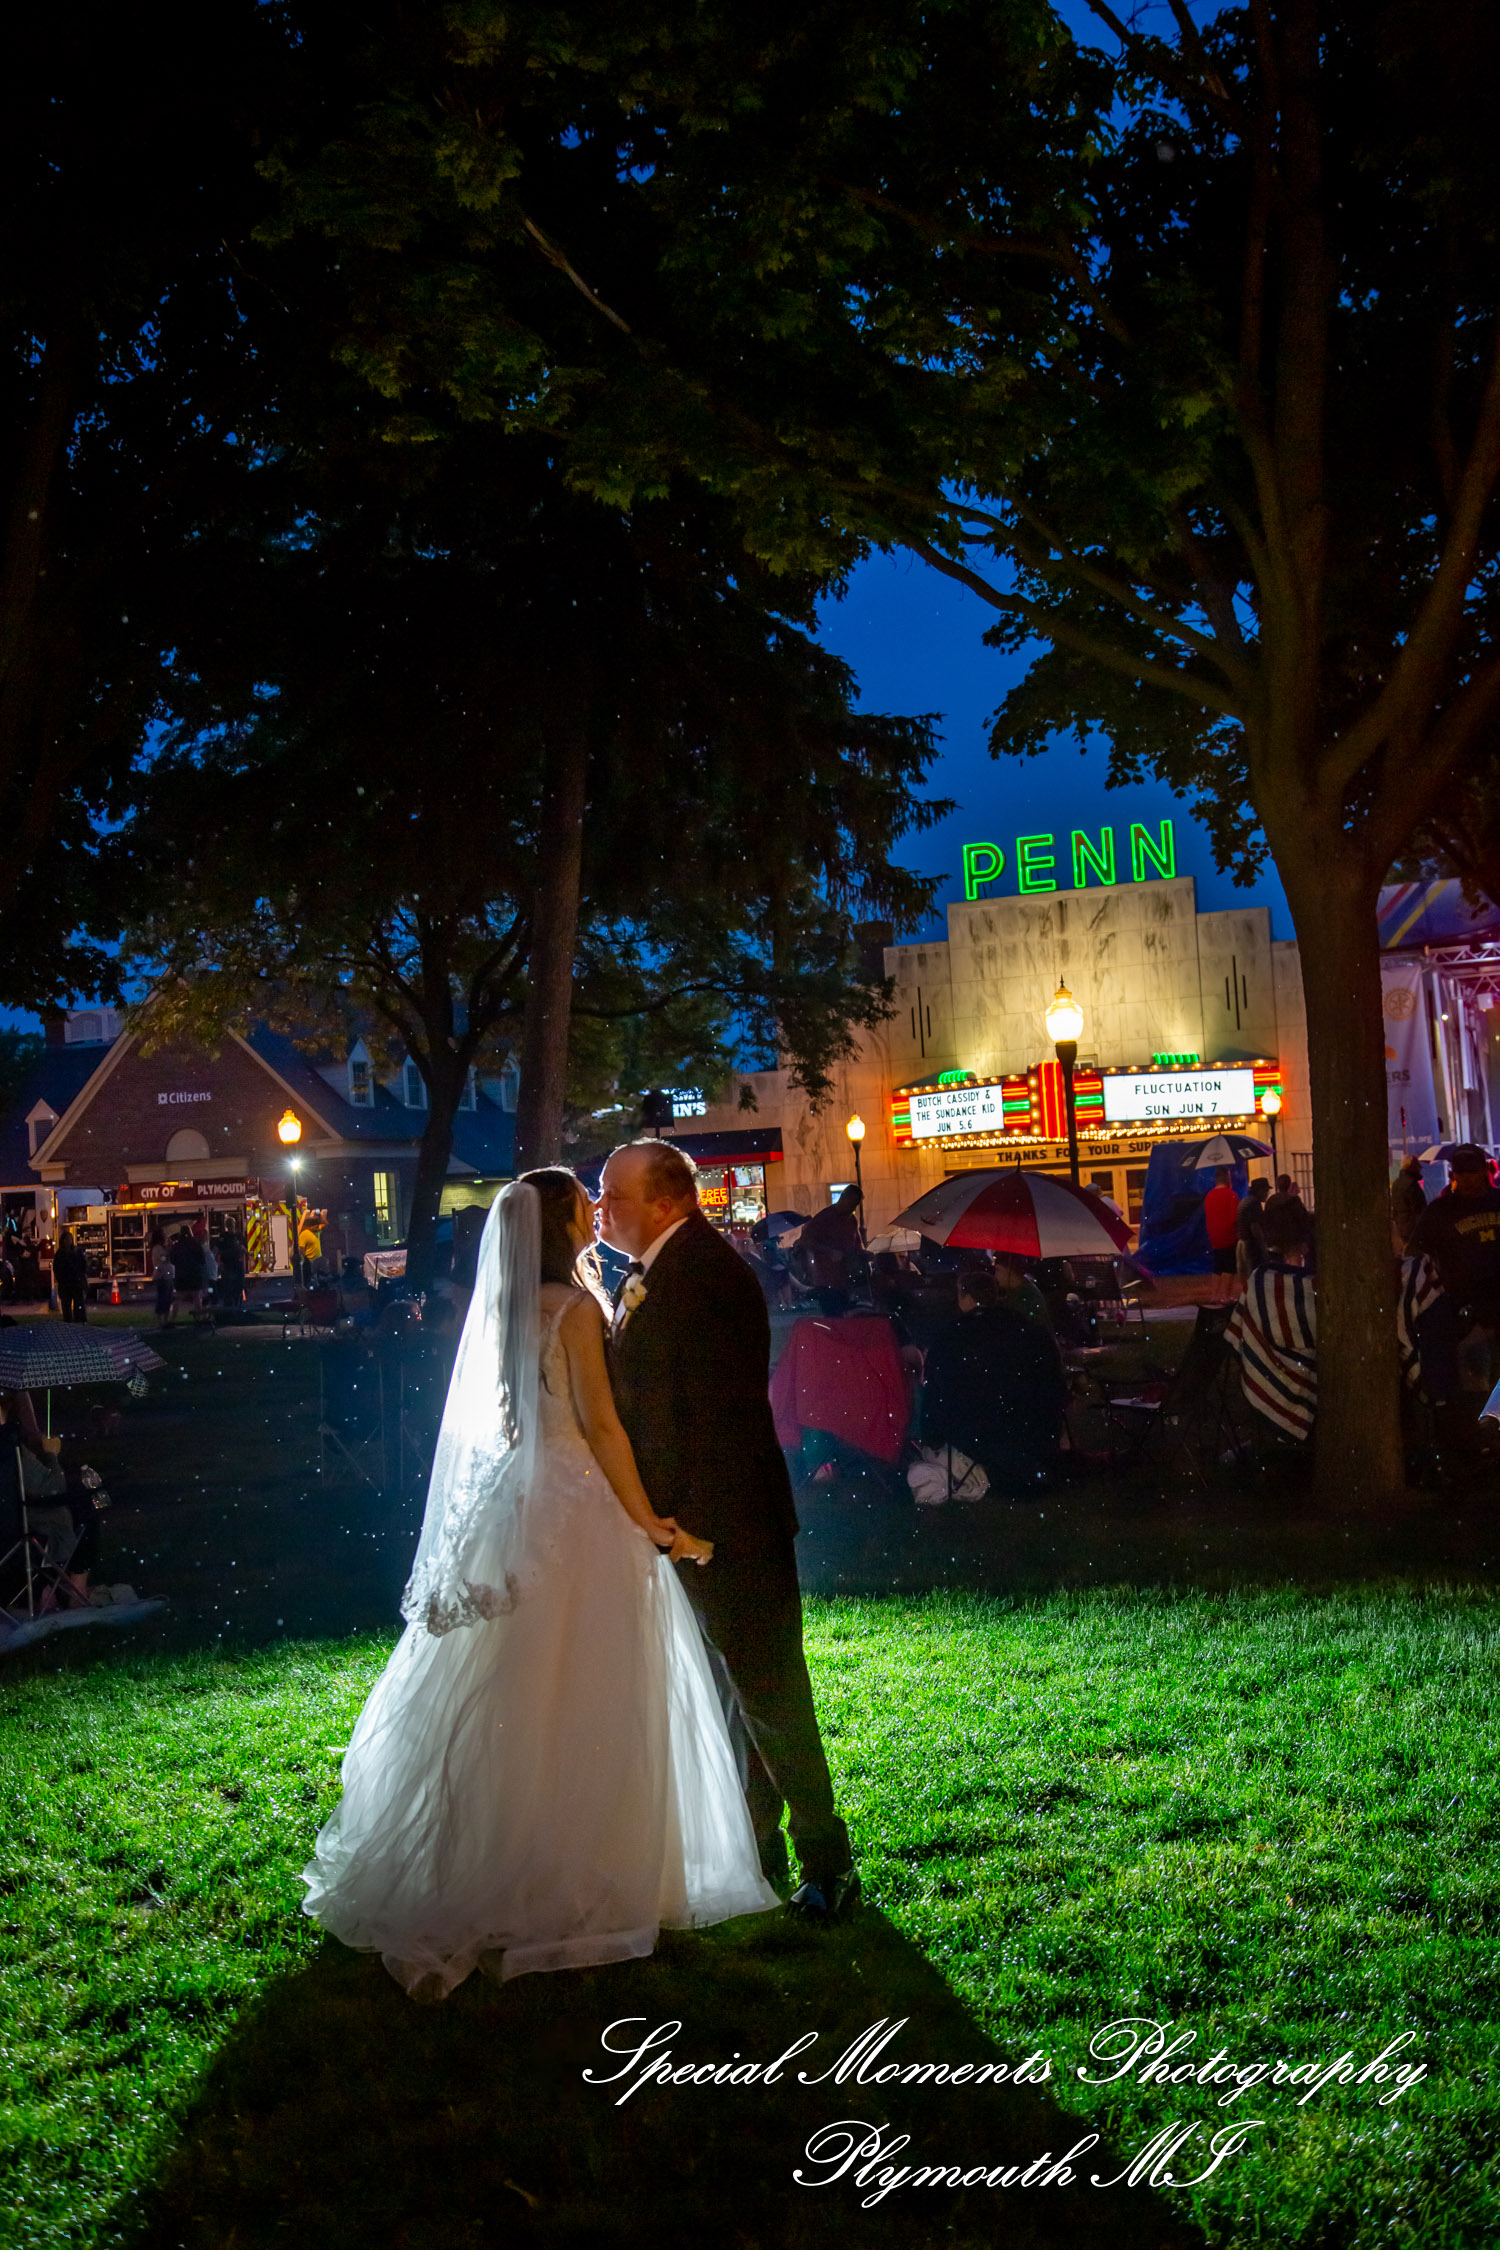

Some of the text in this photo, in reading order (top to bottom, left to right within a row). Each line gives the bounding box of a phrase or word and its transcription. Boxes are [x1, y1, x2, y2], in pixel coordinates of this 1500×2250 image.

[963, 819, 1175, 900] PENN
[1135, 1081, 1221, 1095] FLUCTUATION
[169, 1092, 211, 1104] Citizens
[917, 1089, 990, 1108] BUTCH CASSIDY &
[916, 1103, 995, 1121] THE SUNDANCE KID
[1145, 1102, 1218, 1115] SUN JUN 7
[937, 1122, 951, 1132] JUN
[997, 1149, 1047, 1162] THANKS
[1088, 1143, 1120, 1156] YOUR
[140, 1187, 160, 1198] CITY
[162, 1186, 175, 1197] OF
[197, 1183, 246, 1195] PLYMOUTH
[701, 1188, 727, 1198] FREE
[701, 1198, 728, 1206] SMELLS
